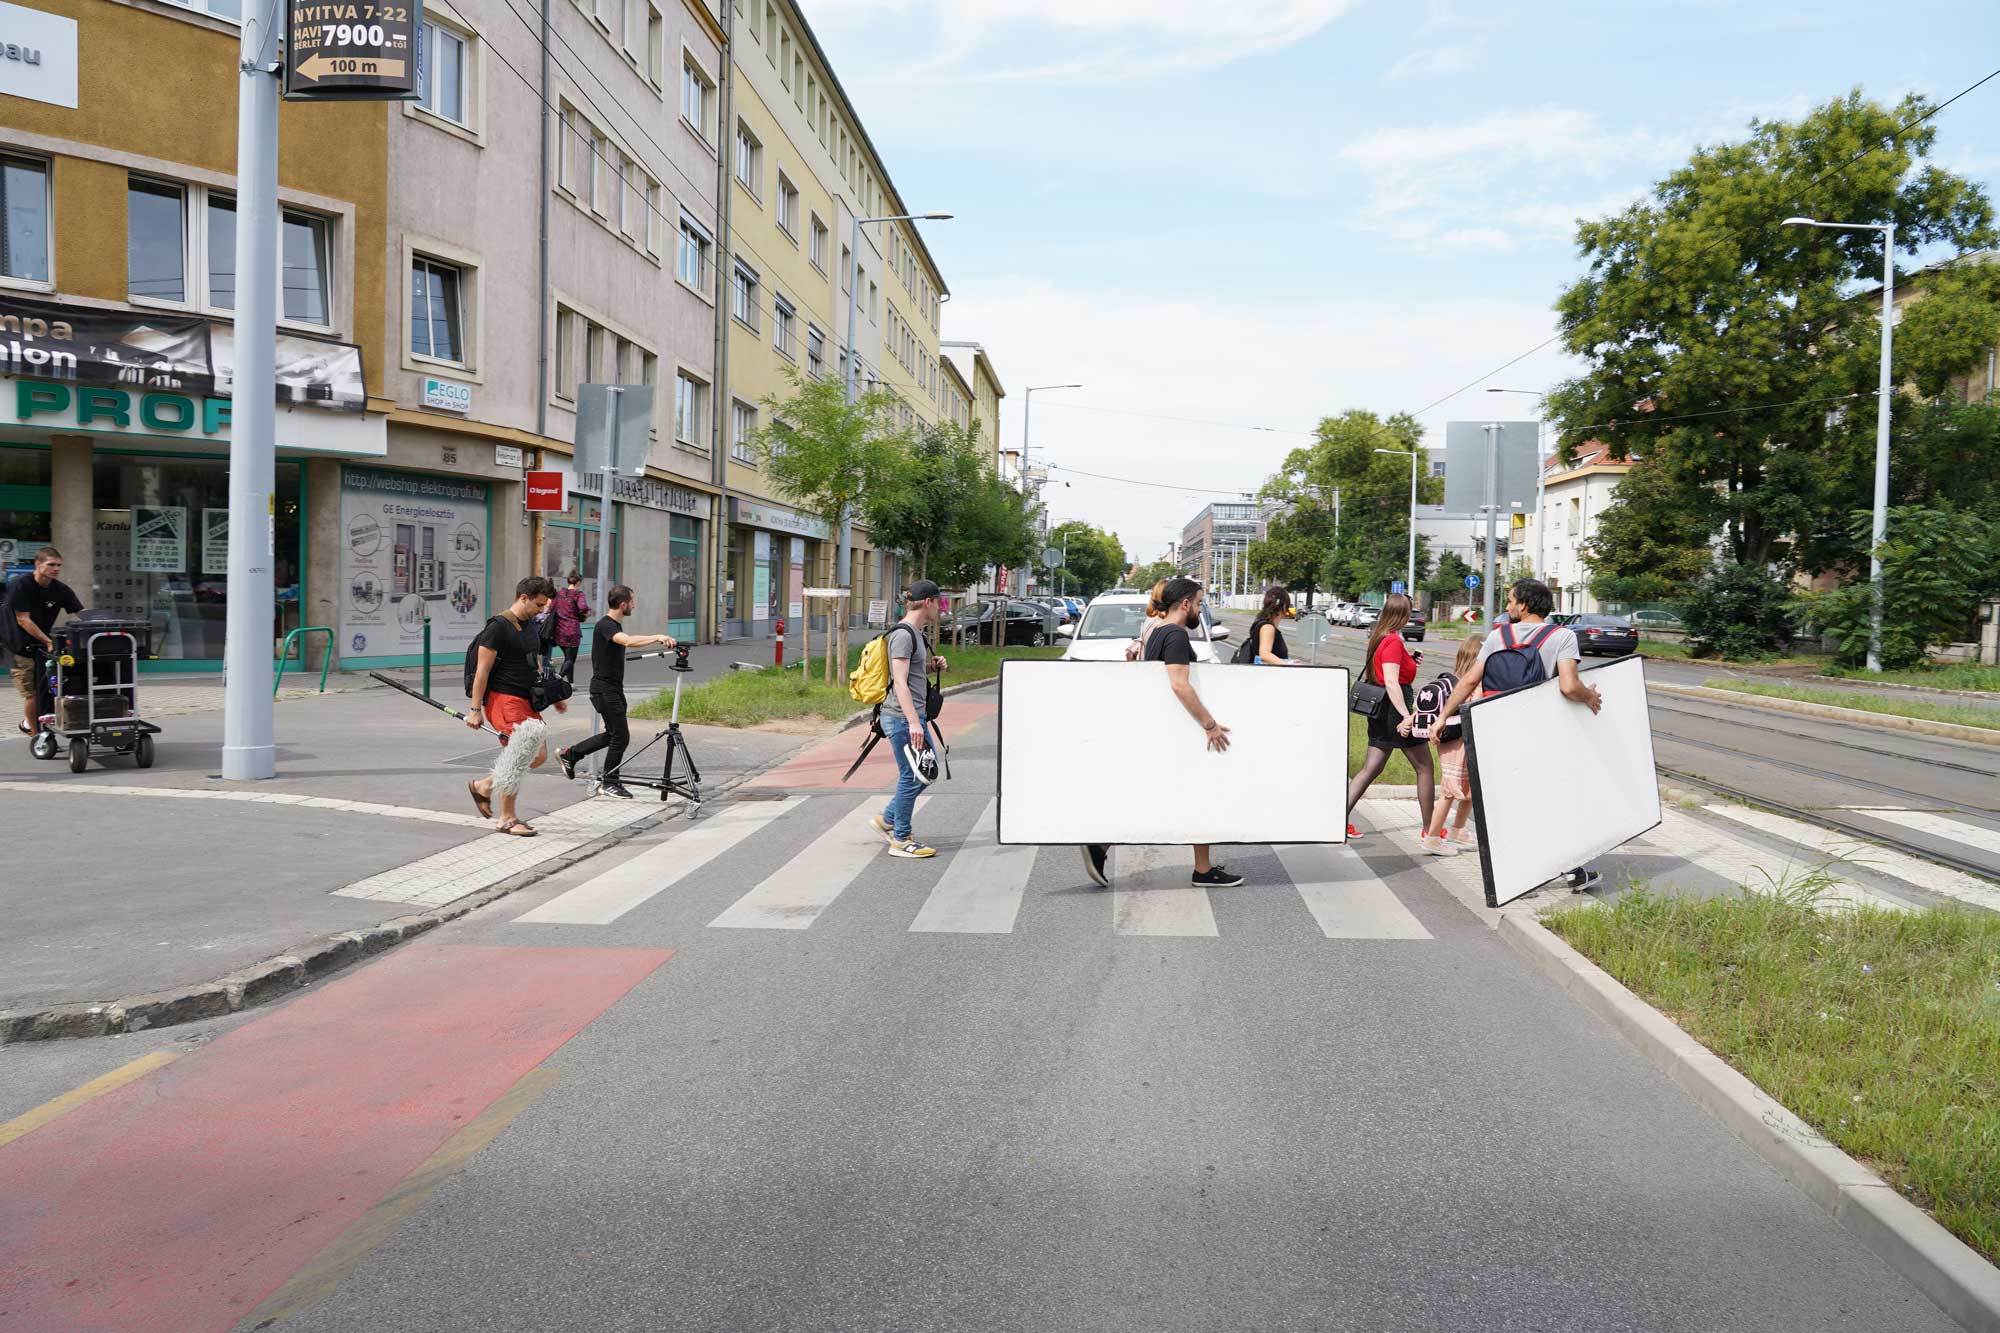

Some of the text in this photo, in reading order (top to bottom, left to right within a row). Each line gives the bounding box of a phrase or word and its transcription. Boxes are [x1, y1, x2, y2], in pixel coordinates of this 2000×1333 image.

[294, 5, 407, 24] NYITVA 7-22
[294, 25, 321, 41] HAVI
[330, 60, 377, 73] 100 m
[439, 383, 470, 401] EGLO
[16, 380, 233, 434] PROF
[426, 396, 444, 405] SHOP
[452, 401, 469, 410] SHOP
[443, 453, 457, 464] 85
[535, 487, 559, 496] legrand
[383, 503, 394, 514] GE
[96, 521, 131, 531] Kanlu
